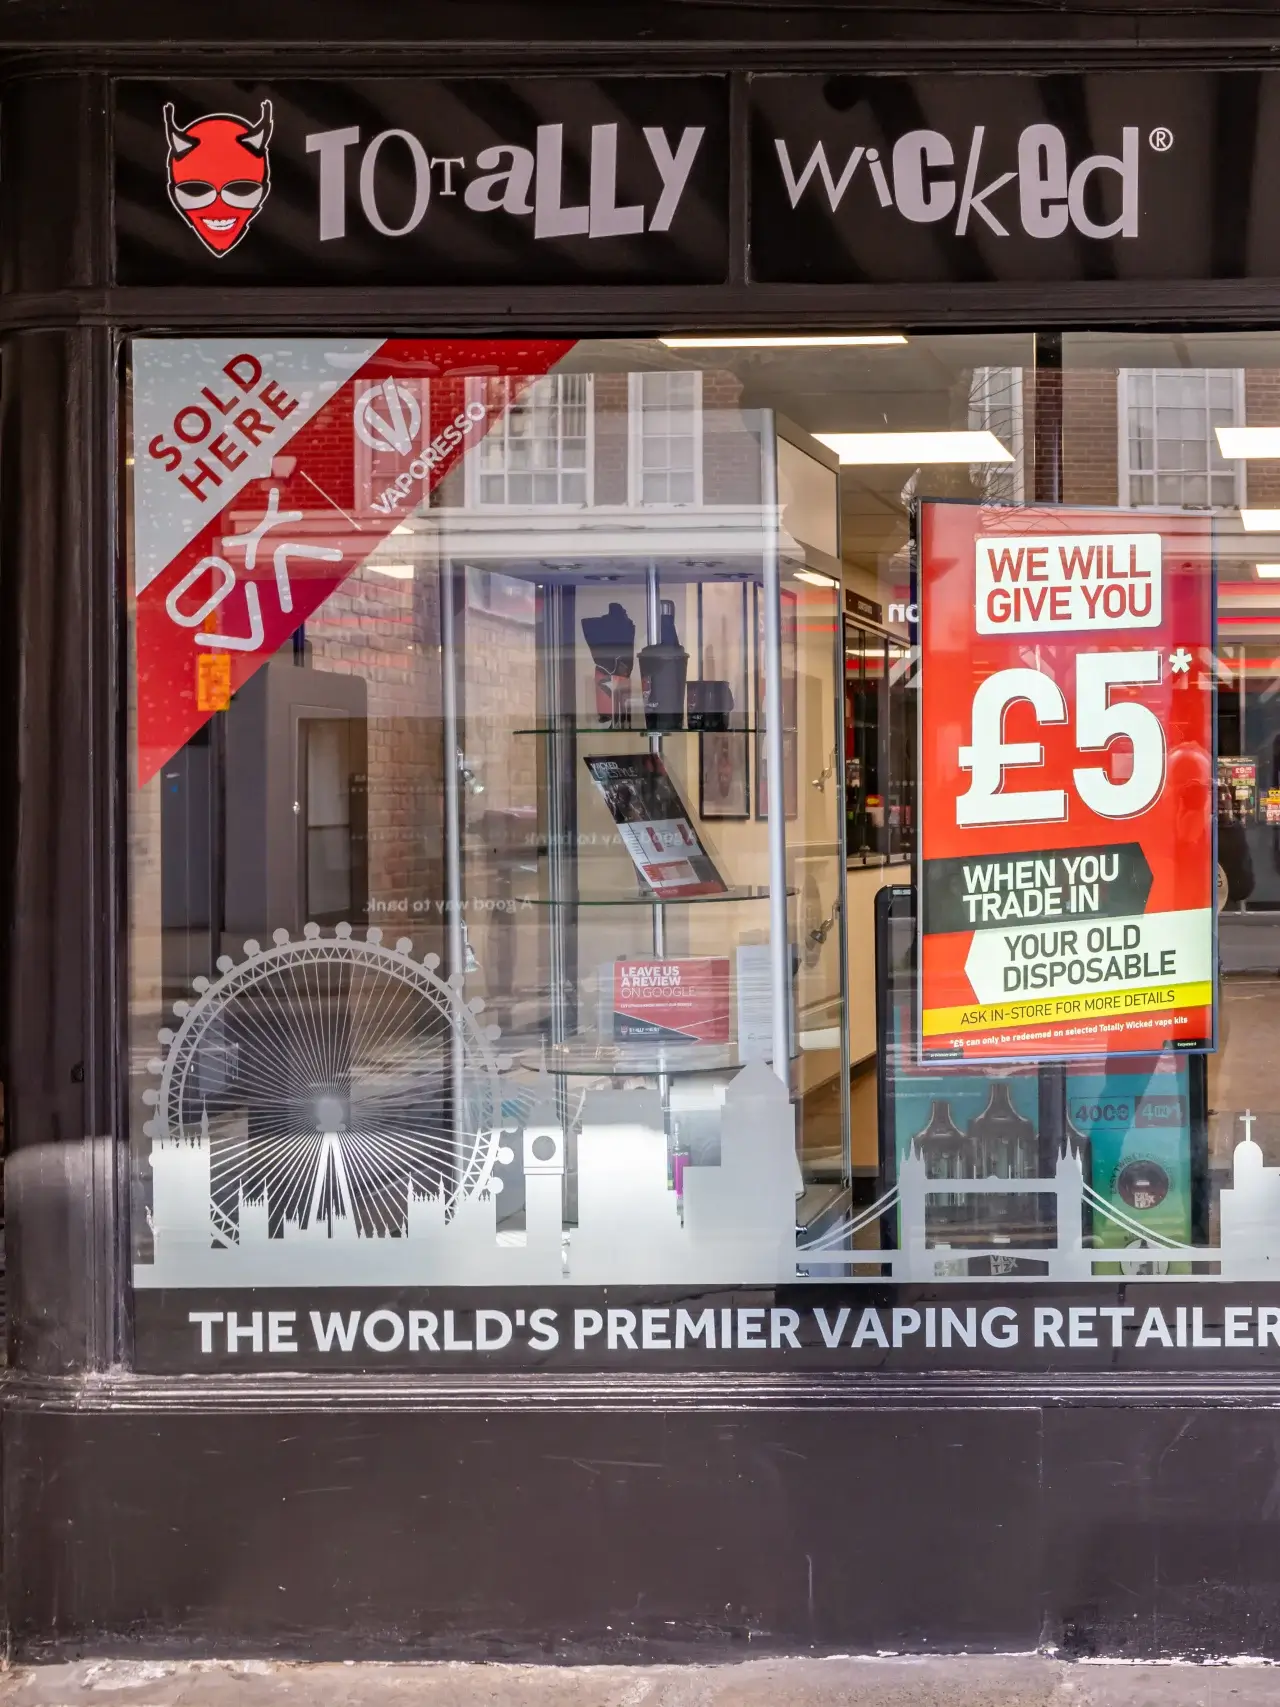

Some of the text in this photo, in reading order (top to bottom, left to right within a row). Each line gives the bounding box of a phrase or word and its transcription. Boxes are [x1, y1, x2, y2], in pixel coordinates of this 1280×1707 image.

[148, 353, 263, 472] SOLD
[178, 380, 300, 502] HERE
[370, 401, 486, 514] VAPORESSO
[986, 544, 1151, 583] WE WILL
[986, 583, 1152, 623] GIVE YOU
[962, 854, 1119, 894] WHEN YOU
[963, 884, 1099, 923] TRADE IN
[1003, 924, 1141, 961] YOUR OLD
[621, 966, 679, 977] LEAVE US
[621, 976, 681, 987] A REVIEW
[1003, 950, 1177, 992] DISPOSABLE
[621, 986, 696, 998] ON GOOGLE
[961, 990, 1175, 1025] ASK IN-STORE FOR MORE DETAILS
[982, 1036, 999, 1045] only
[1001, 1034, 1010, 1042] be
[1012, 1030, 1051, 1041] redeemed
[1065, 1025, 1098, 1035] selected
[1099, 1023, 1124, 1033] Totally
[1125, 1020, 1152, 1029] Wicked
[1154, 1018, 1172, 1028] vape
[1174, 1016, 1188, 1024] kits
[188, 1310, 298, 1353] THE
[309, 1308, 559, 1352] WORLD'S
[573, 1307, 802, 1350] PREMIER
[812, 1306, 1020, 1349] VAPING
